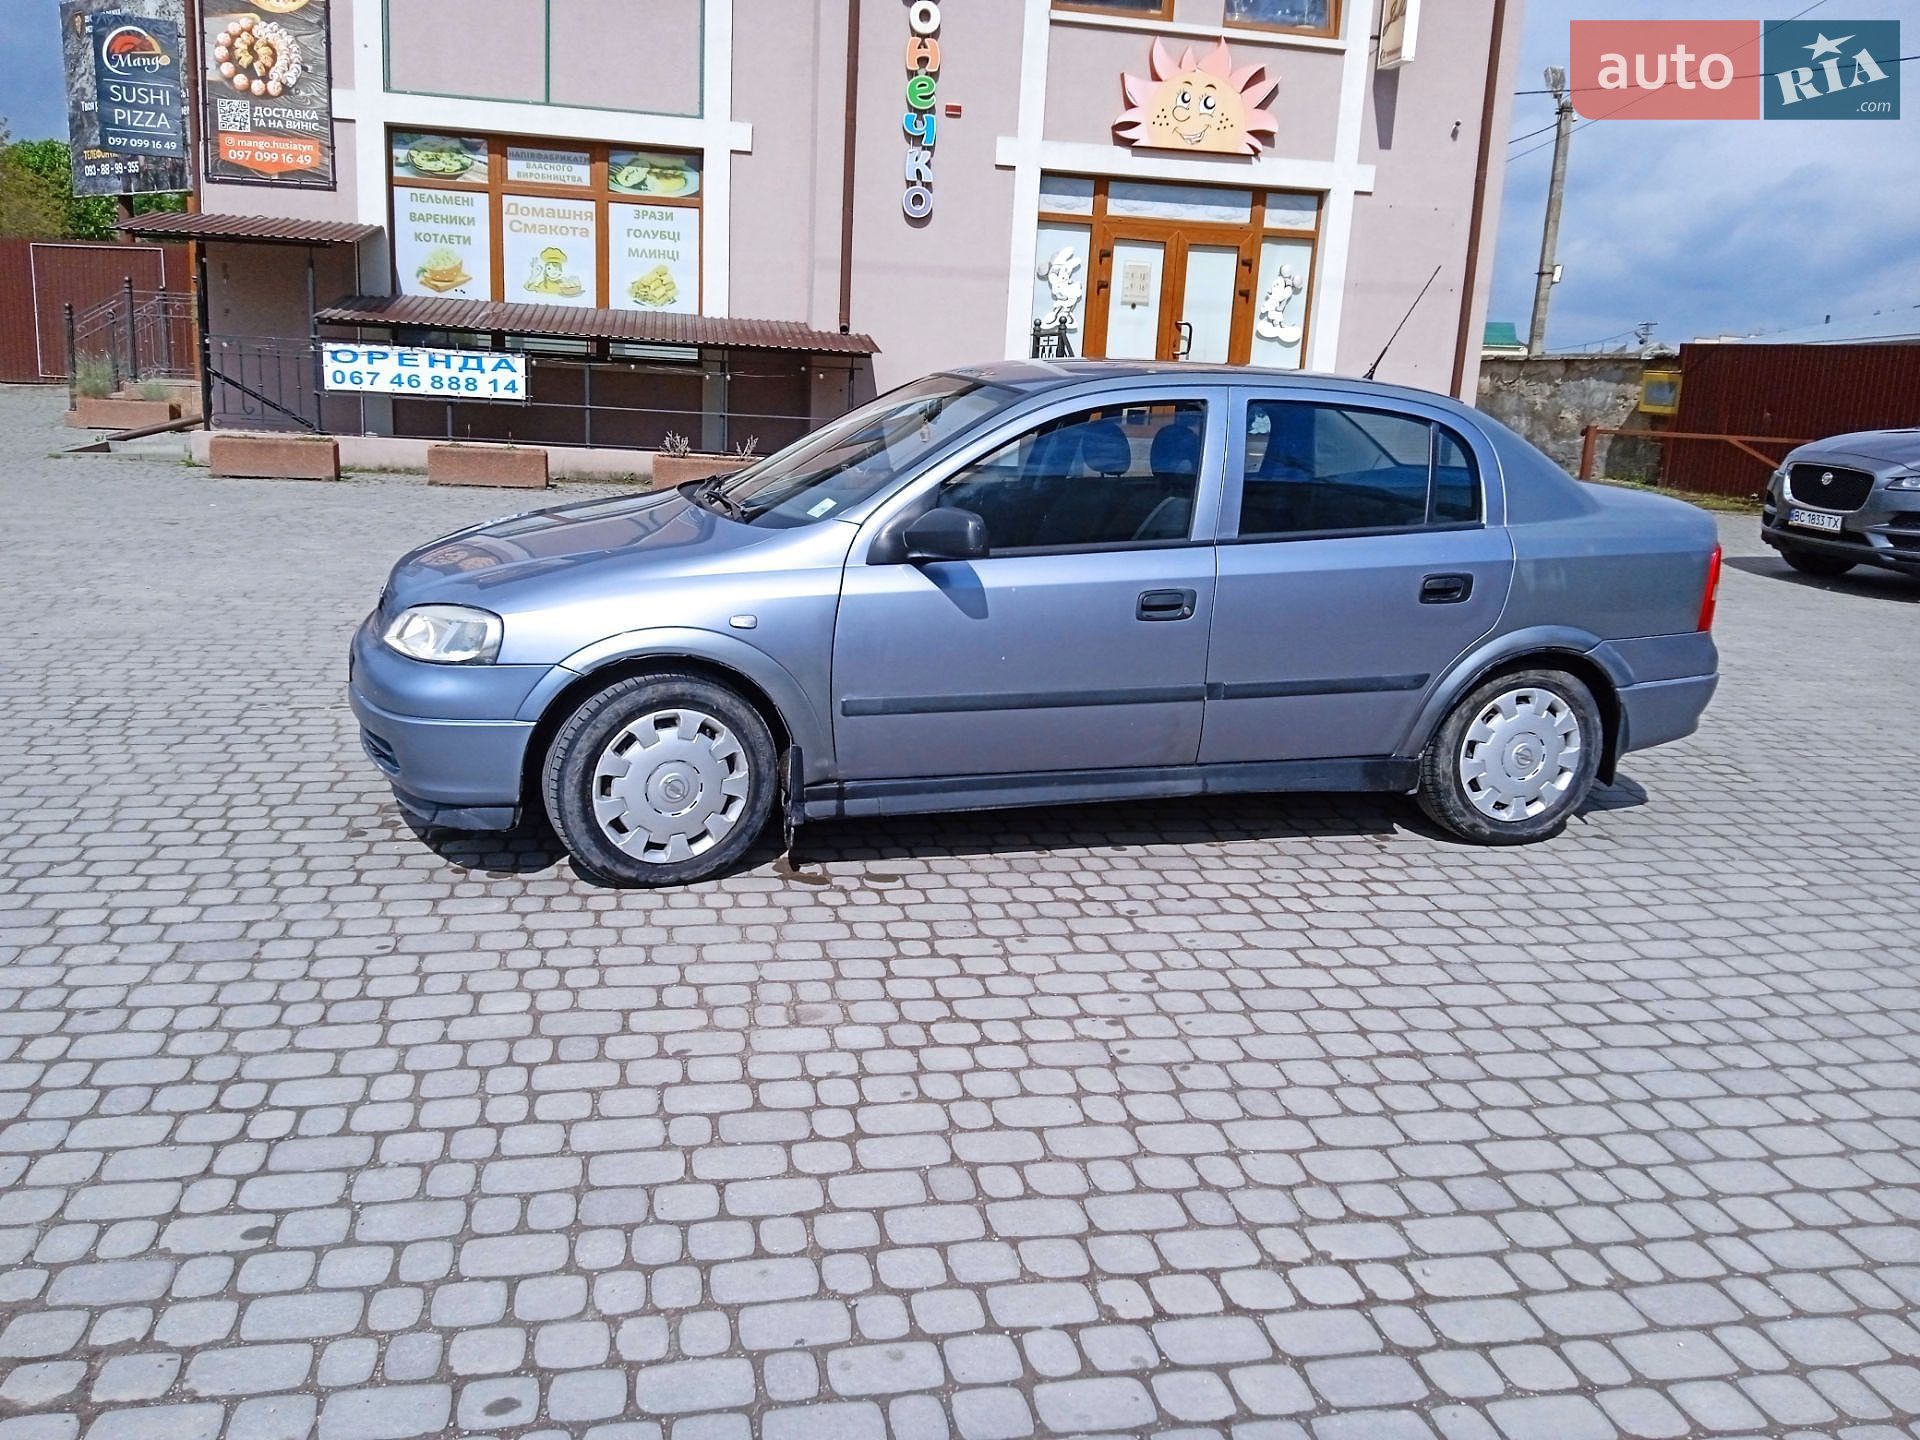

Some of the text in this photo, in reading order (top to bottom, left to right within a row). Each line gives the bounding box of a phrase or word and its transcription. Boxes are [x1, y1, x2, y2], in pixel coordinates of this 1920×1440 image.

[111, 53, 170, 73] Mango
[110, 85, 170, 106] SUSHI
[114, 108, 171, 129] PIZZA
[253, 106, 319, 120] ДОСТАВКА
[252, 118, 320, 131] ТА НА ВИНІС
[108, 136, 177, 150] 097 099 16 49
[237, 139, 314, 152] mango.husiatyn
[228, 149, 312, 165] 097 099 16 49
[525, 161, 573, 172] ВЛАСНОГО
[410, 192, 474, 207] ПЕЛЬМЕНІ
[409, 211, 476, 226] ВАРЕНИКИ
[504, 202, 594, 221] Домашня
[633, 208, 674, 221] ЗРАЗИ
[509, 219, 590, 238] Смакота
[626, 228, 681, 243] ГОЛУБЦІ
[414, 232, 472, 245] КОТЛЕТИ
[627, 247, 680, 262] МЛИНЦІ
[331, 350, 518, 374] ОРЕНДА
[332, 370, 518, 394] 067 46 888 14
[1807, 513, 1825, 526] 1833
[1827, 516, 1840, 529] TX
